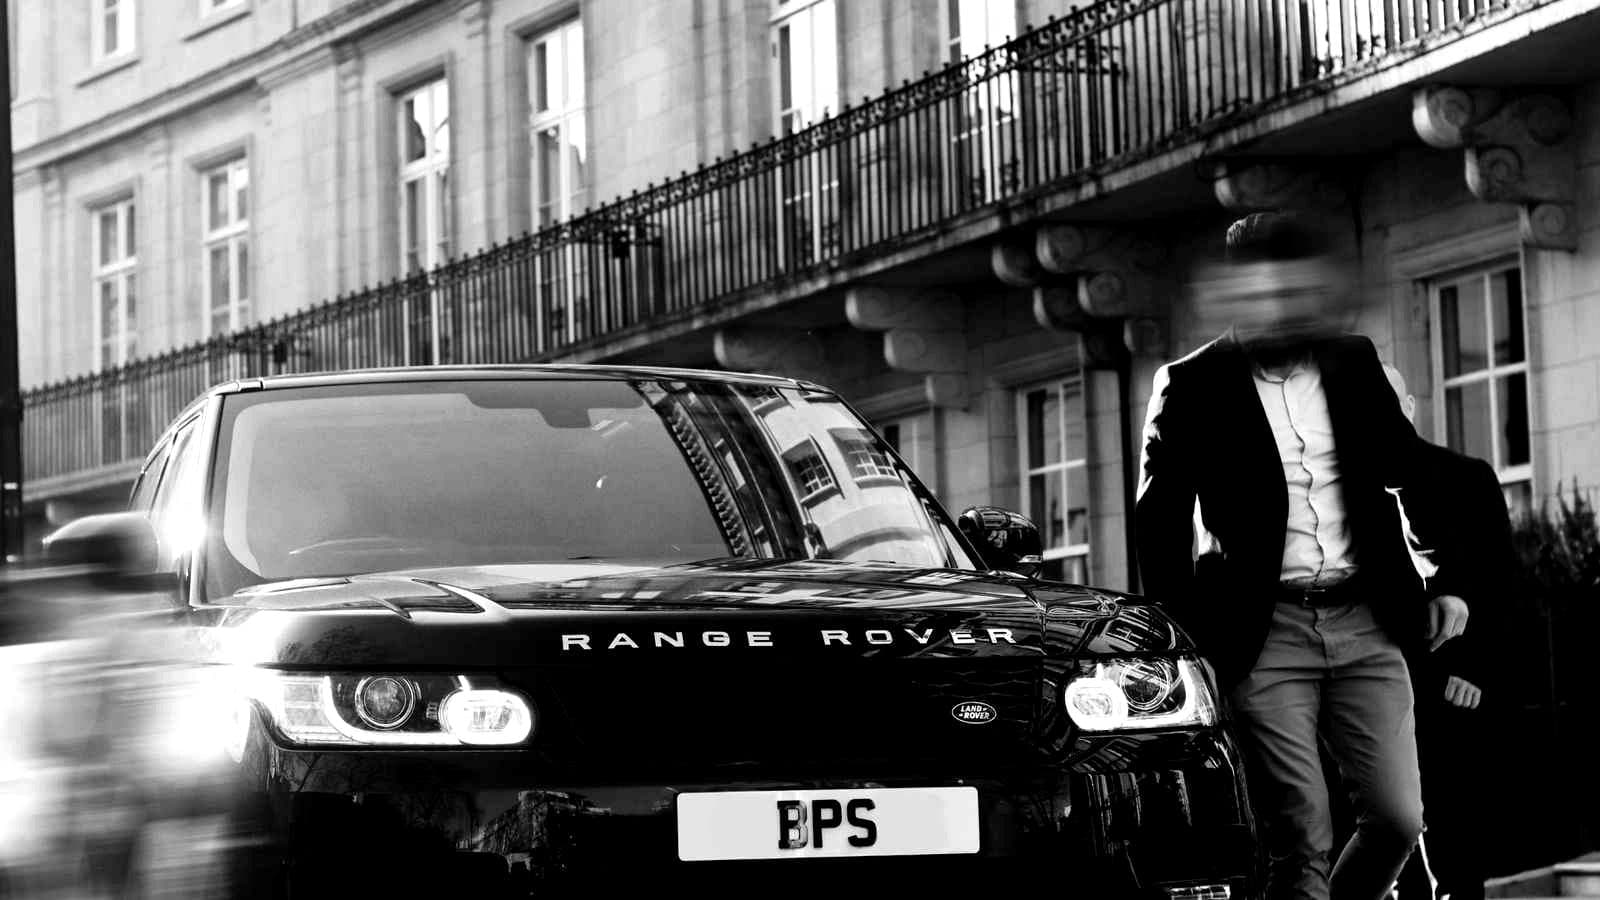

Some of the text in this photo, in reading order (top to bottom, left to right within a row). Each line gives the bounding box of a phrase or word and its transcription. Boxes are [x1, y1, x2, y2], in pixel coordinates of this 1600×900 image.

[562, 628, 1017, 650] RANGE ROVER
[777, 797, 877, 850] BPS
